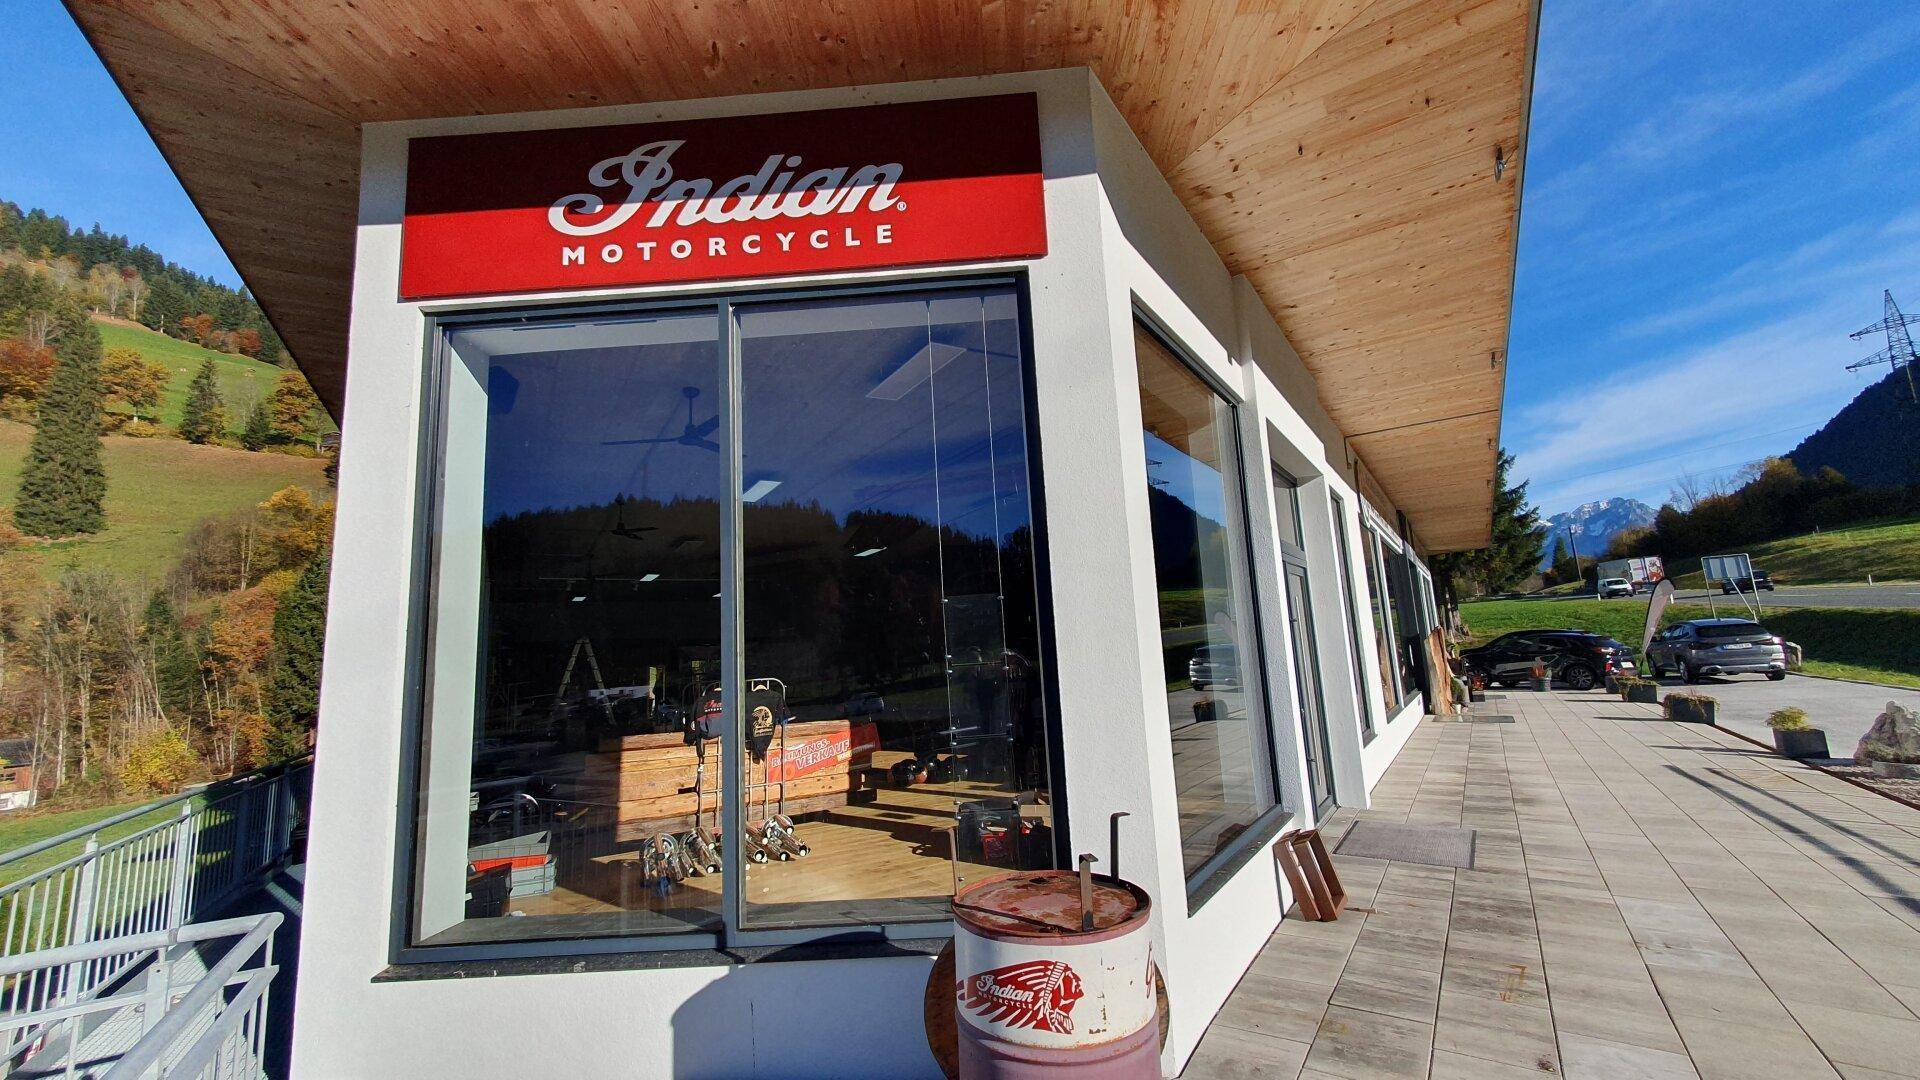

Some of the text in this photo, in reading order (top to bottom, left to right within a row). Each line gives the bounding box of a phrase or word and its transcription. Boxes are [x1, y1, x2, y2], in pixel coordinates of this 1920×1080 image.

[547, 139, 904, 236] Indian
[561, 225, 894, 267] MOTORCYCLE
[796, 740, 850, 769] VERKAUF
[976, 974, 1034, 1002] Indian
